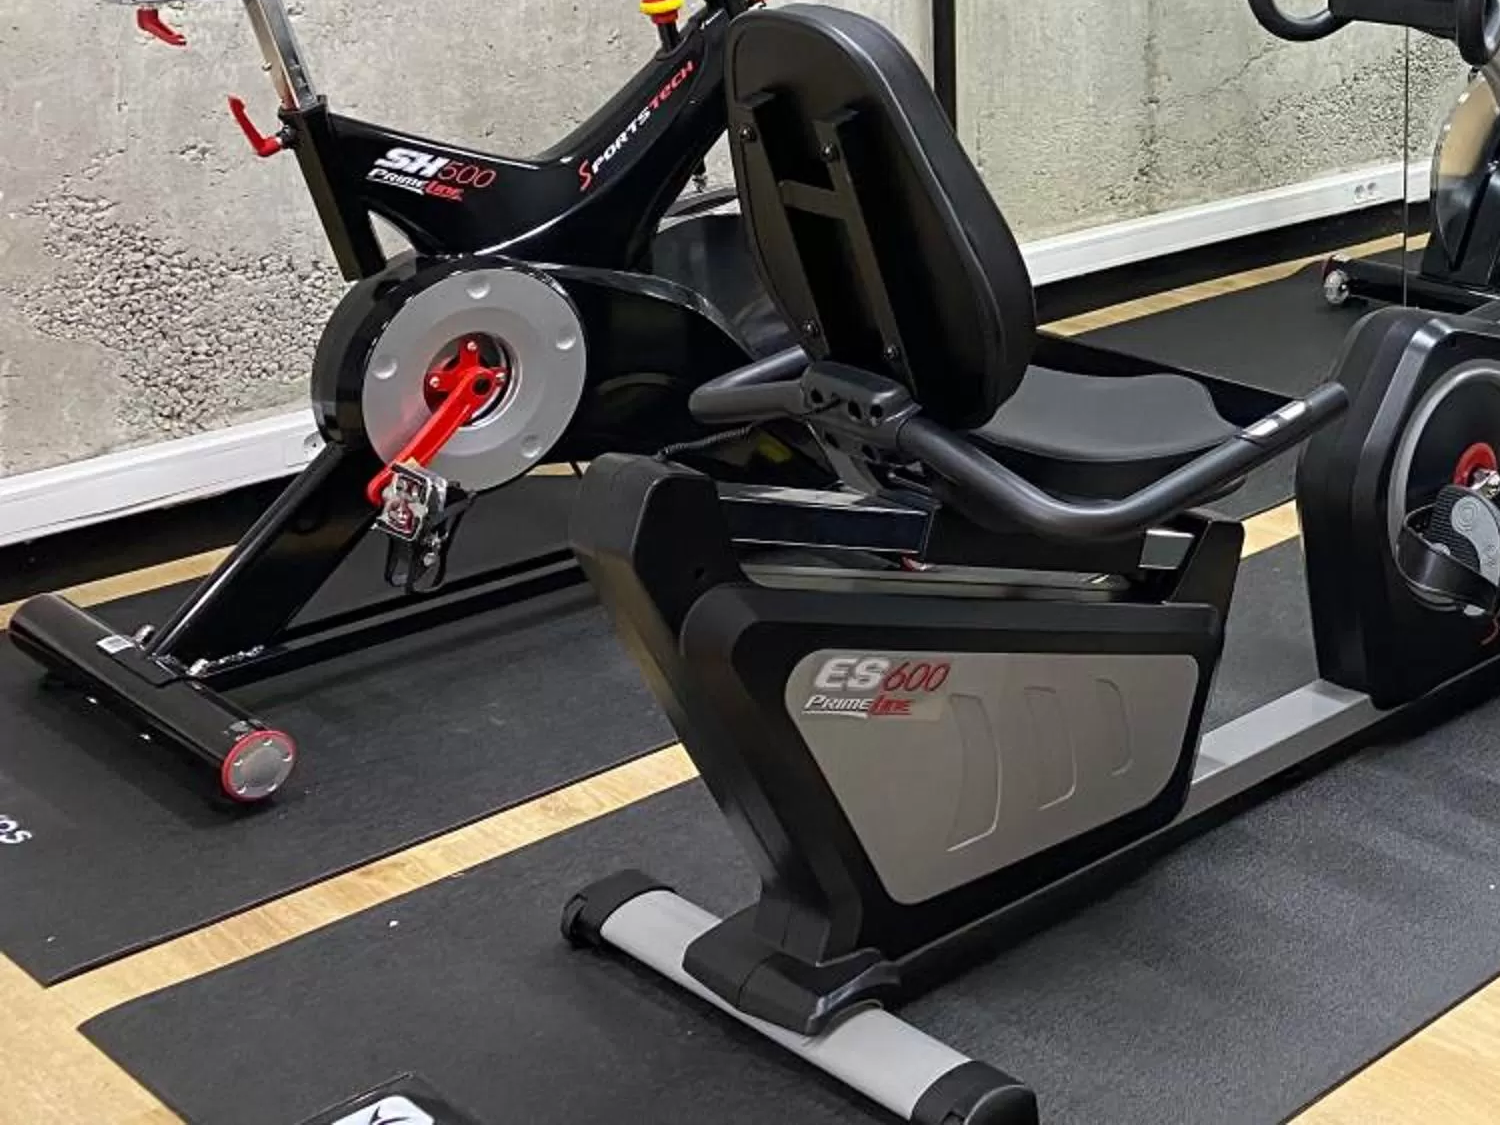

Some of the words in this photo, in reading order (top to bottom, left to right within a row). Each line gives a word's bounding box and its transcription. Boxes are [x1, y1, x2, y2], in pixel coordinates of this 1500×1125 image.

[579, 60, 696, 192] SPORTSTECH
[374, 147, 498, 188] SH500
[815, 658, 951, 692] ES600
